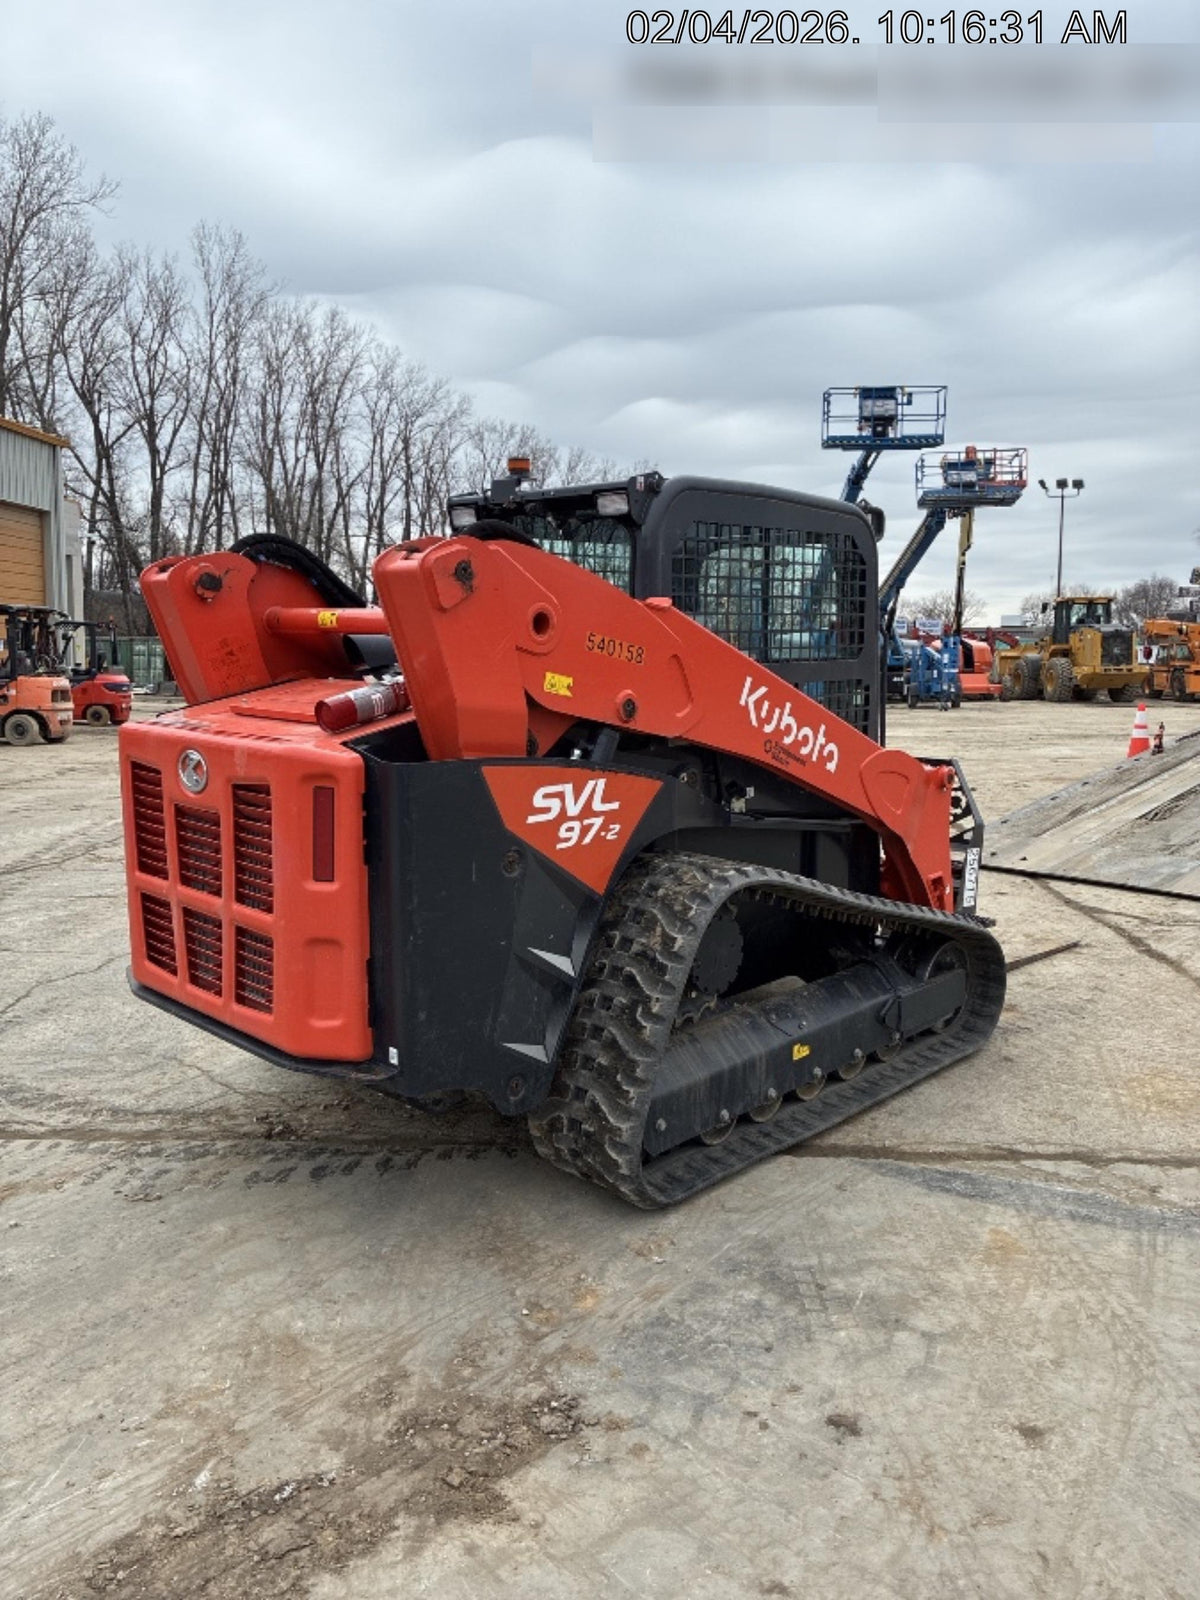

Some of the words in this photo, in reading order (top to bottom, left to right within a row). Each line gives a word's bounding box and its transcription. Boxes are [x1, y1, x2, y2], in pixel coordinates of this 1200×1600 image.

[586, 632, 645, 664] 540158
[739, 676, 839, 774] Kubota
[526, 778, 620, 824] SVL
[556, 816, 621, 850] 97-2
